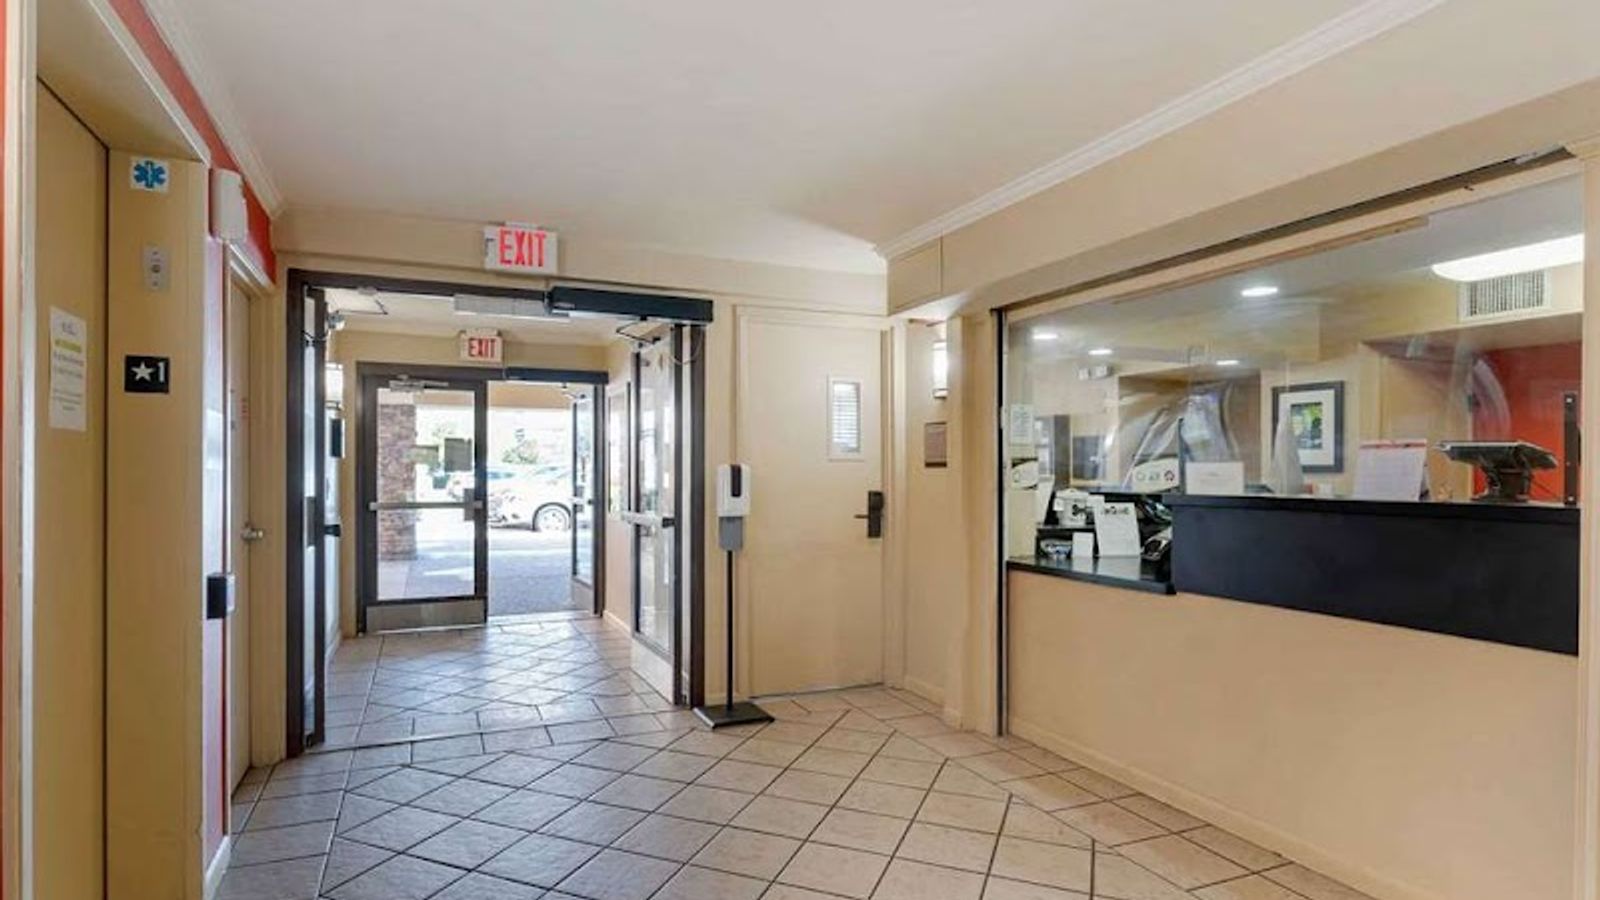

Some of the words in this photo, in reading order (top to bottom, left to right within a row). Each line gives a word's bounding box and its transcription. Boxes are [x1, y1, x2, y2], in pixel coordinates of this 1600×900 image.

[499, 229, 545, 267] EXIT
[468, 337, 497, 358] EXIT
[158, 361, 166, 382] 1
